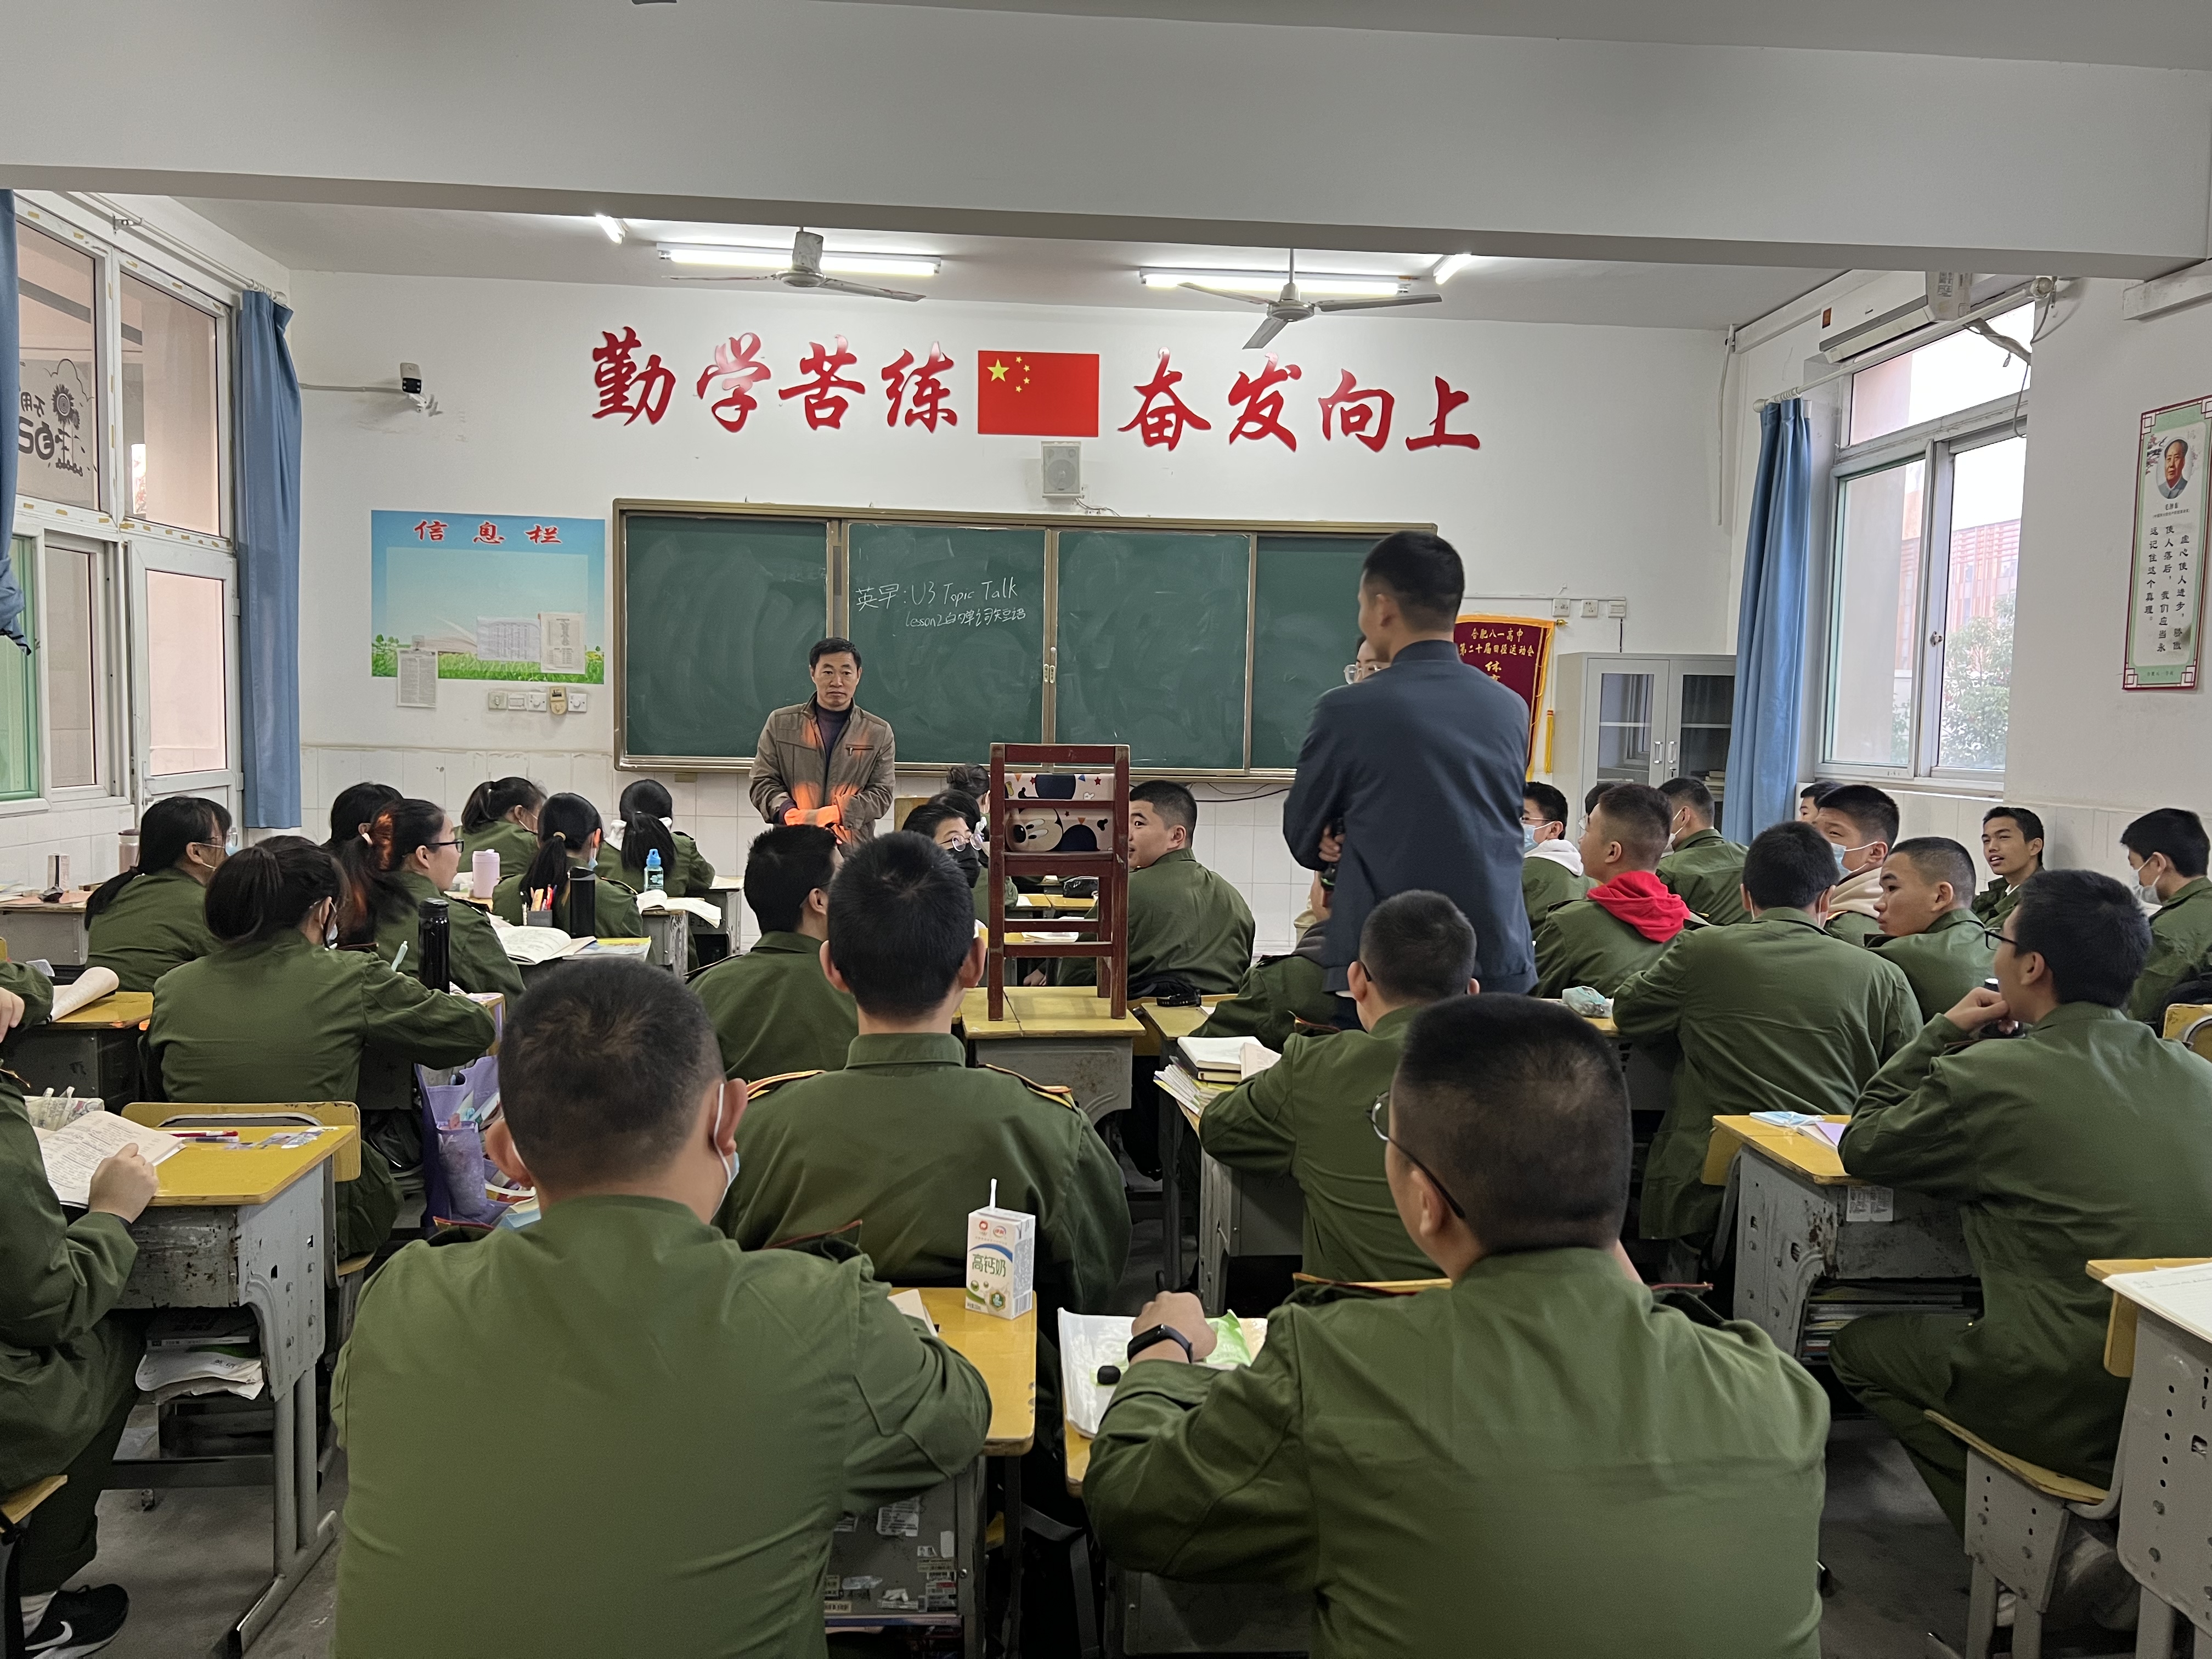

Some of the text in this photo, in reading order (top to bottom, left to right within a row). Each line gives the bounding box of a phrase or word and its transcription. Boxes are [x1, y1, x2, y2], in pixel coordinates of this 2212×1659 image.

[591, 326, 1481, 453] 勤学苦练 奋发向上
[414, 520, 562, 544] 信息栏
[943, 582, 975, 607] Topic
[981, 577, 1018, 601] Talk
[1471, 627, 1523, 642] 合肥八一高中
[1459, 642, 1534, 657] 第二十届田径运动会
[972, 1253, 1006, 1277] 高钙奶
